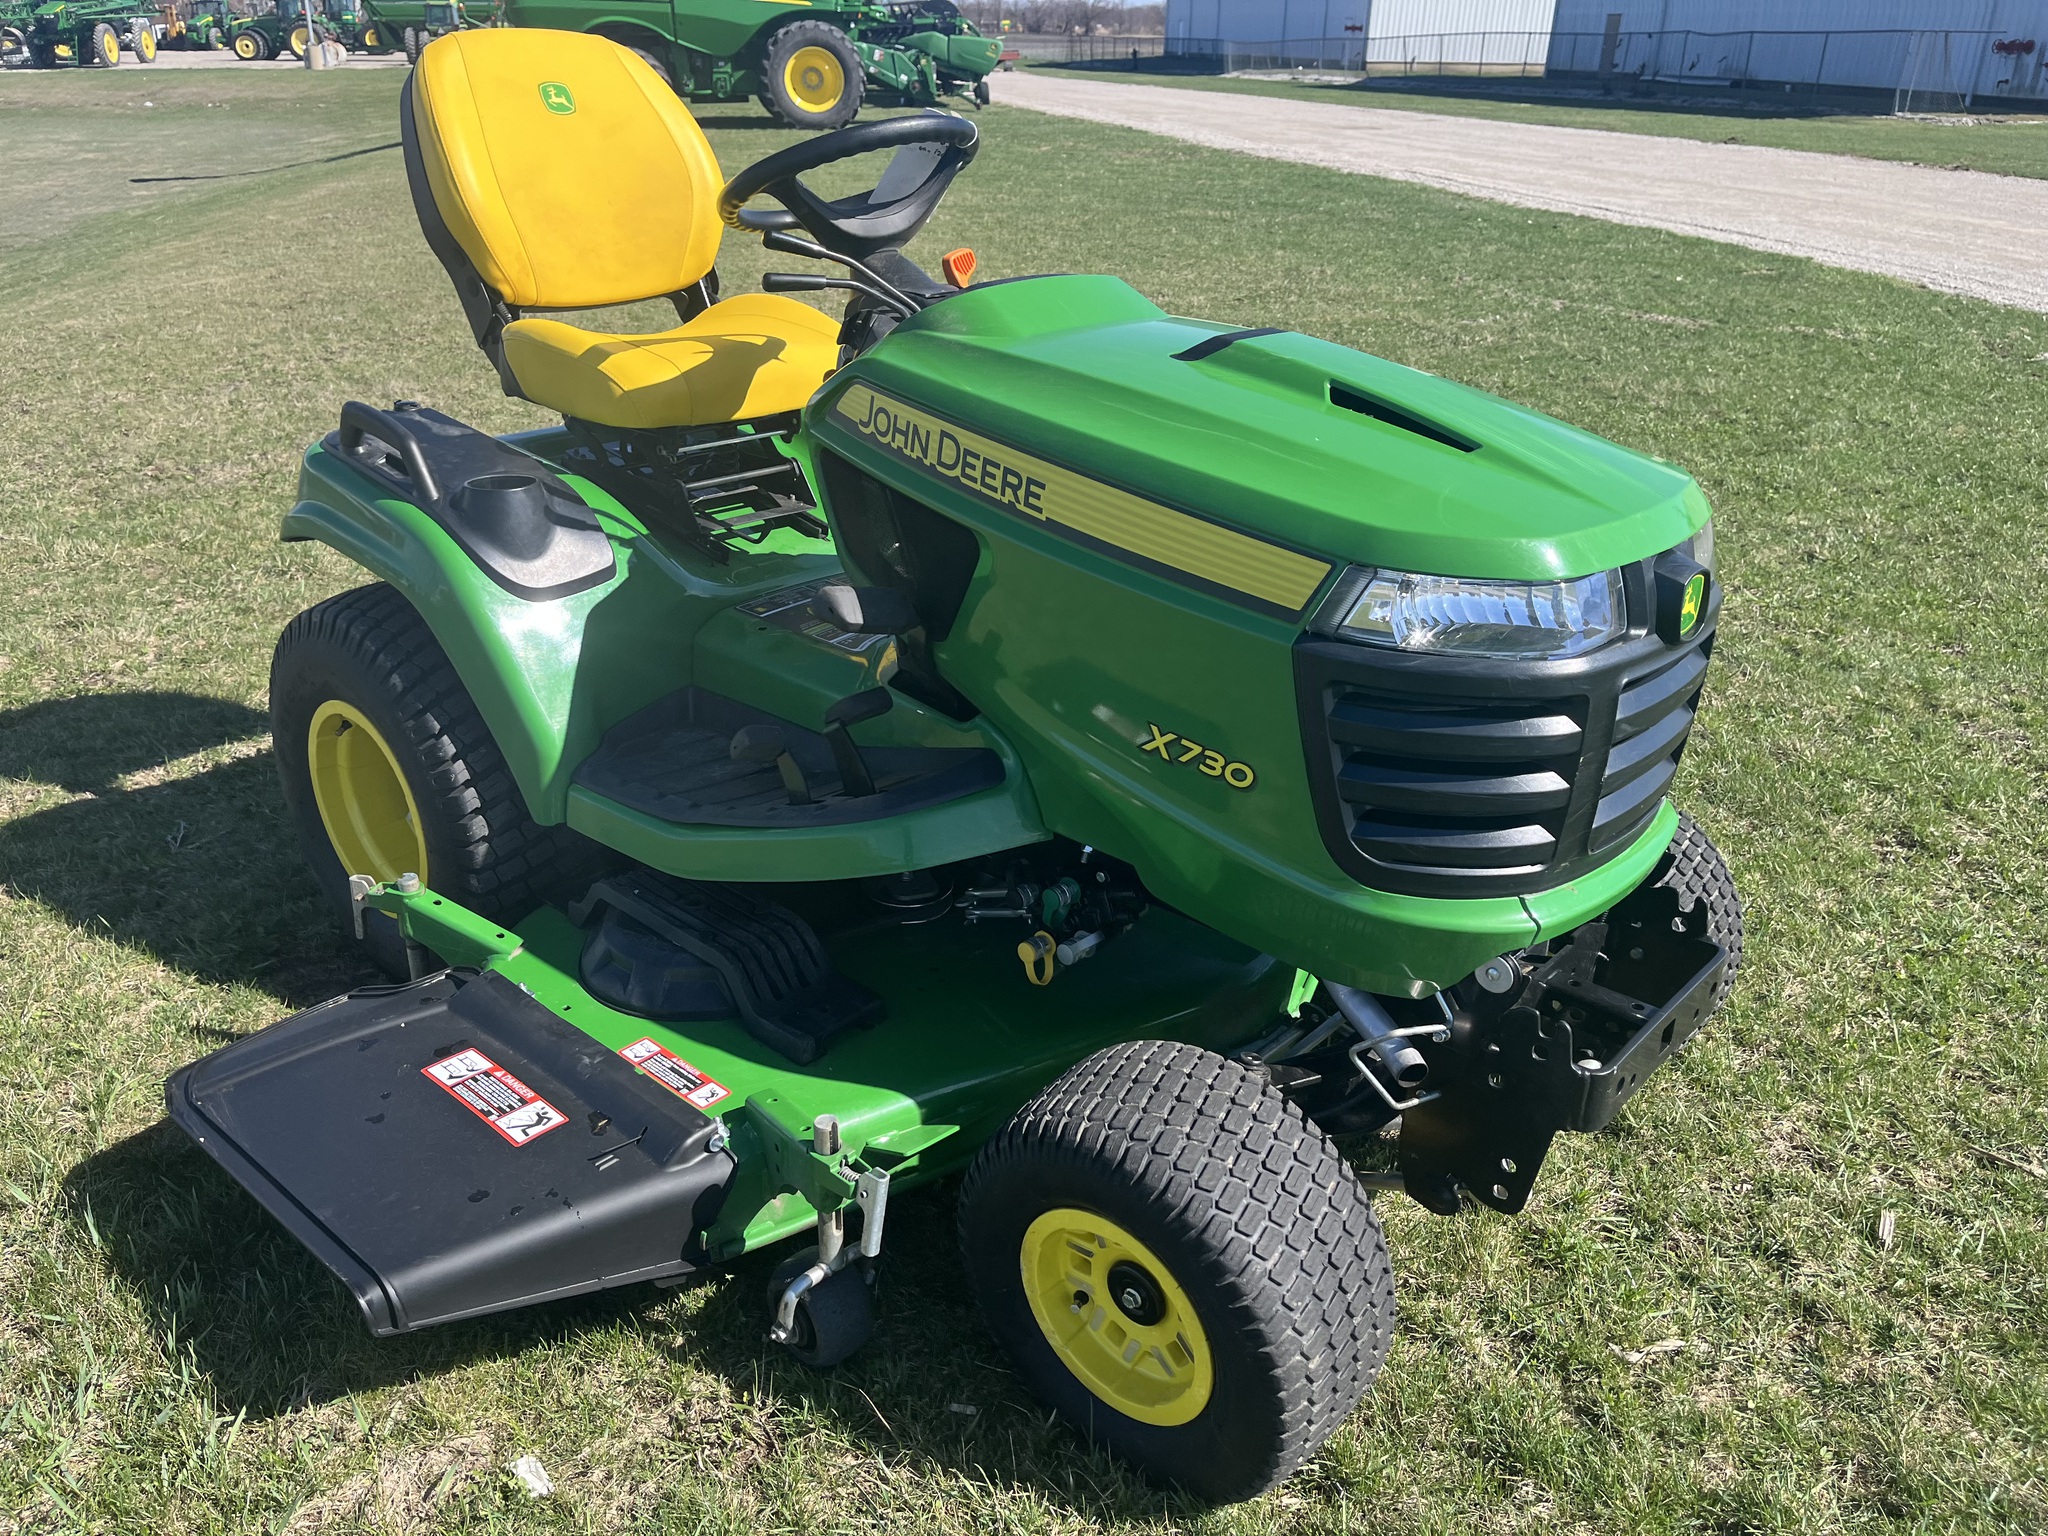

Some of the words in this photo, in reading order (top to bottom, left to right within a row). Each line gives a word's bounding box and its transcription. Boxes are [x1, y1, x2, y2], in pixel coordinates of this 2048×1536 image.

[859, 395, 931, 460] JOHN
[936, 429, 1046, 515] DEERE
[1140, 722, 1255, 789] X730
[501, 1074, 535, 1099] DANGER
[676, 1059, 701, 1076] DANGER
